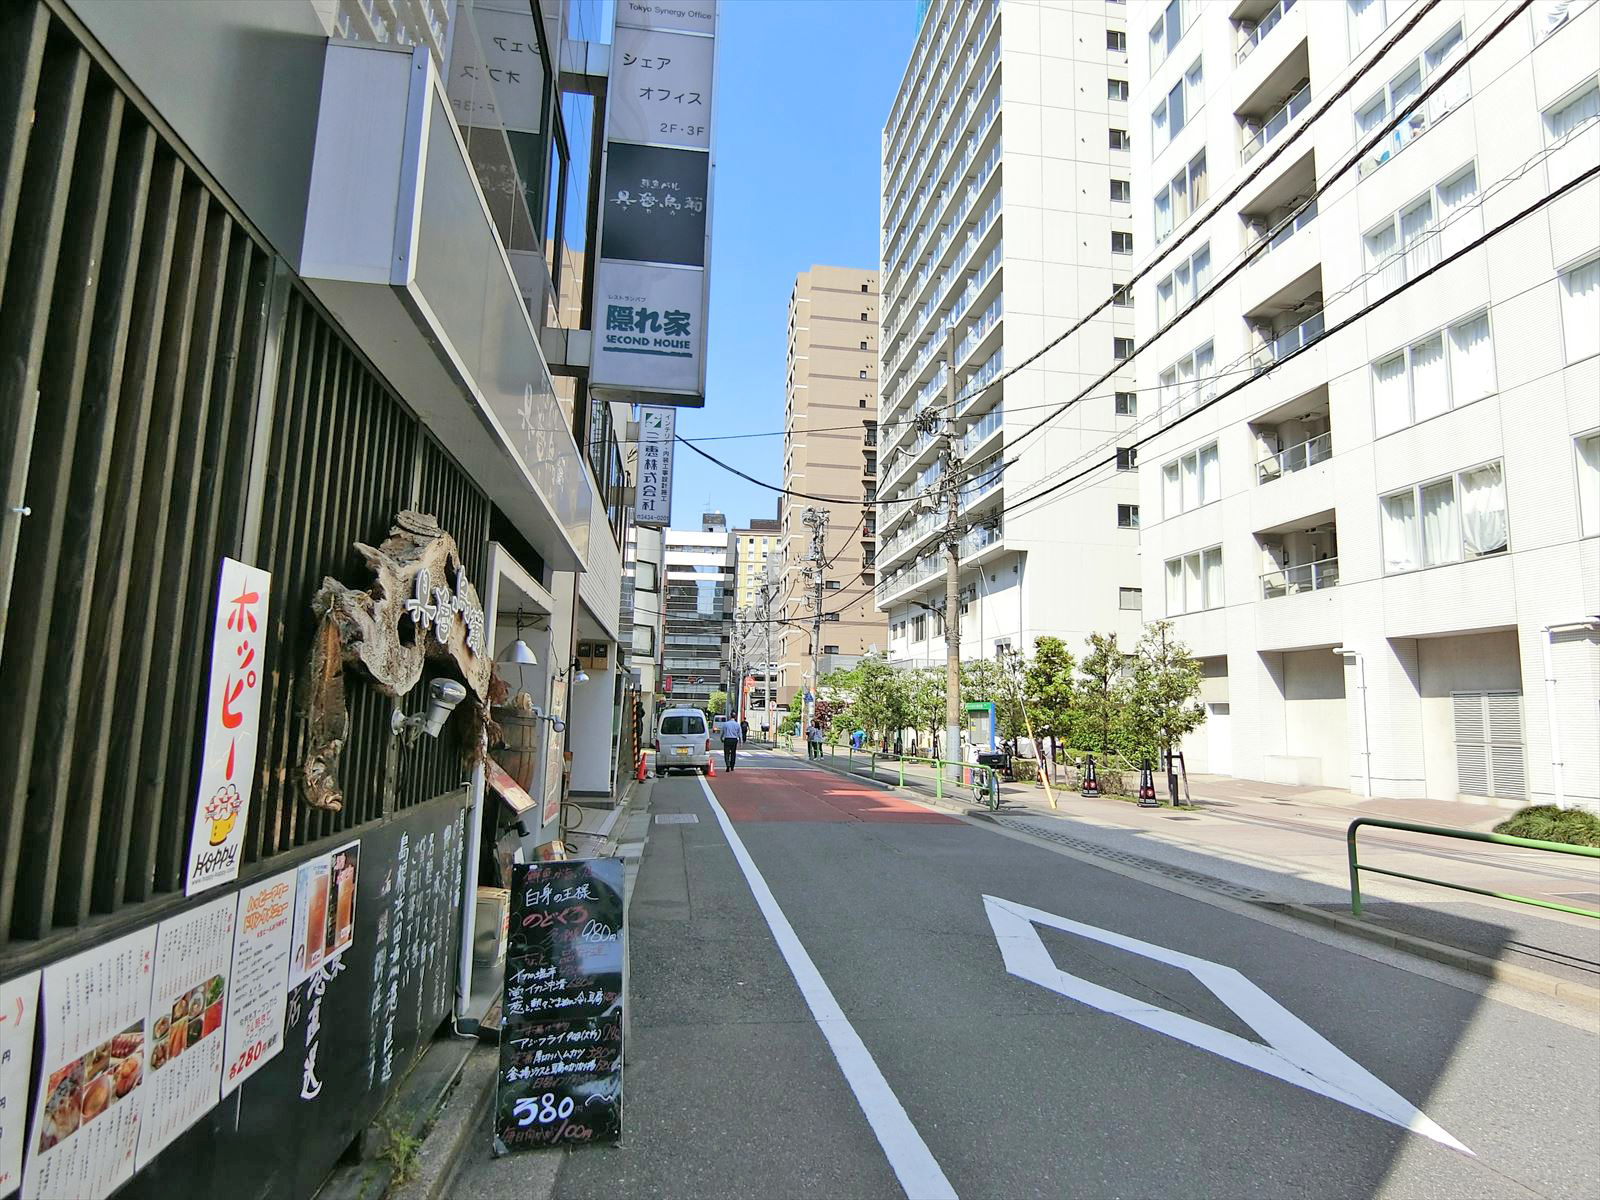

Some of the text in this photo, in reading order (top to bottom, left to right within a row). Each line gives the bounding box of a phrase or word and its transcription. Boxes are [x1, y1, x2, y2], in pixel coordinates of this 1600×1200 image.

[629, 2, 712, 20] Tokyo Synergy Office
[623, 52, 671, 70] シェア
[639, 87, 702, 105] オフィス
[606, 304, 692, 337] 隠れ家
[606, 334, 691, 349] SECOND HOUSE
[222, 574, 261, 782] ホッピー
[192, 843, 239, 879] Hoppy
[525, 882, 600, 907] 白身の王様
